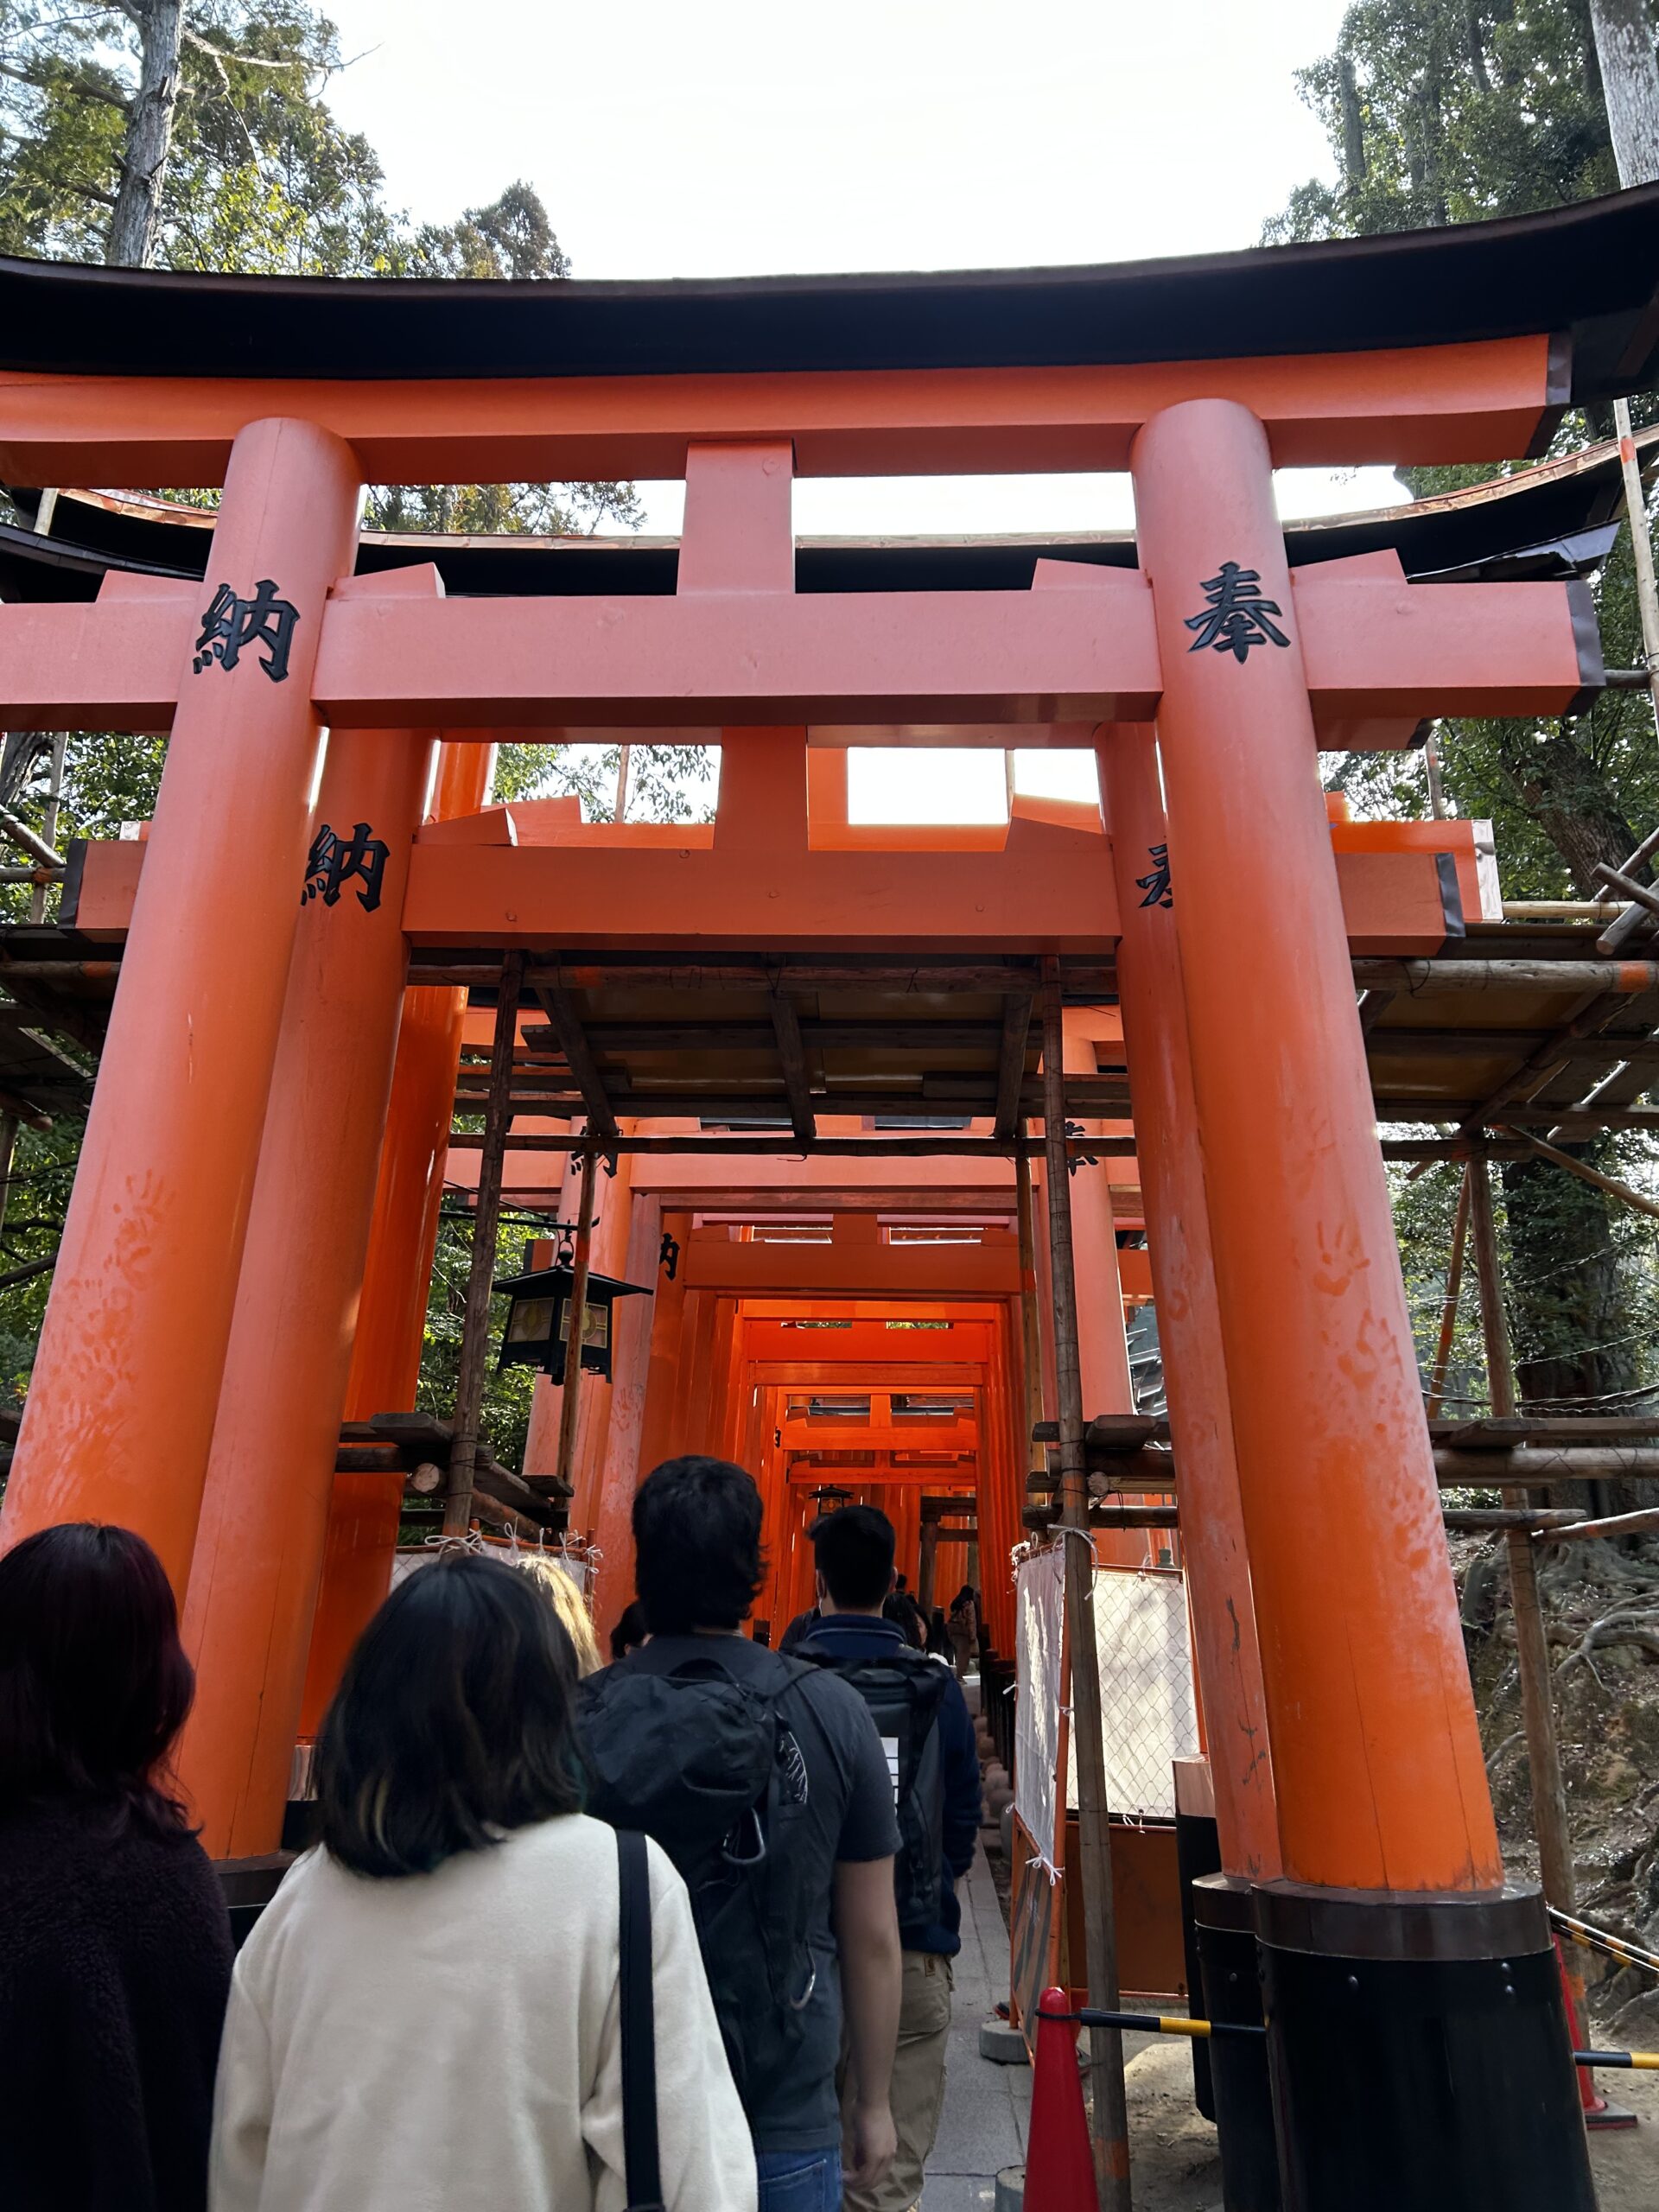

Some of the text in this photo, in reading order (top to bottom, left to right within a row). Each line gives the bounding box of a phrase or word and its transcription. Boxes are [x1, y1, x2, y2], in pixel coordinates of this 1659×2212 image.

[193, 579, 301, 683] 納
[1183, 561, 1291, 664] 奉
[300, 823, 390, 912] 納
